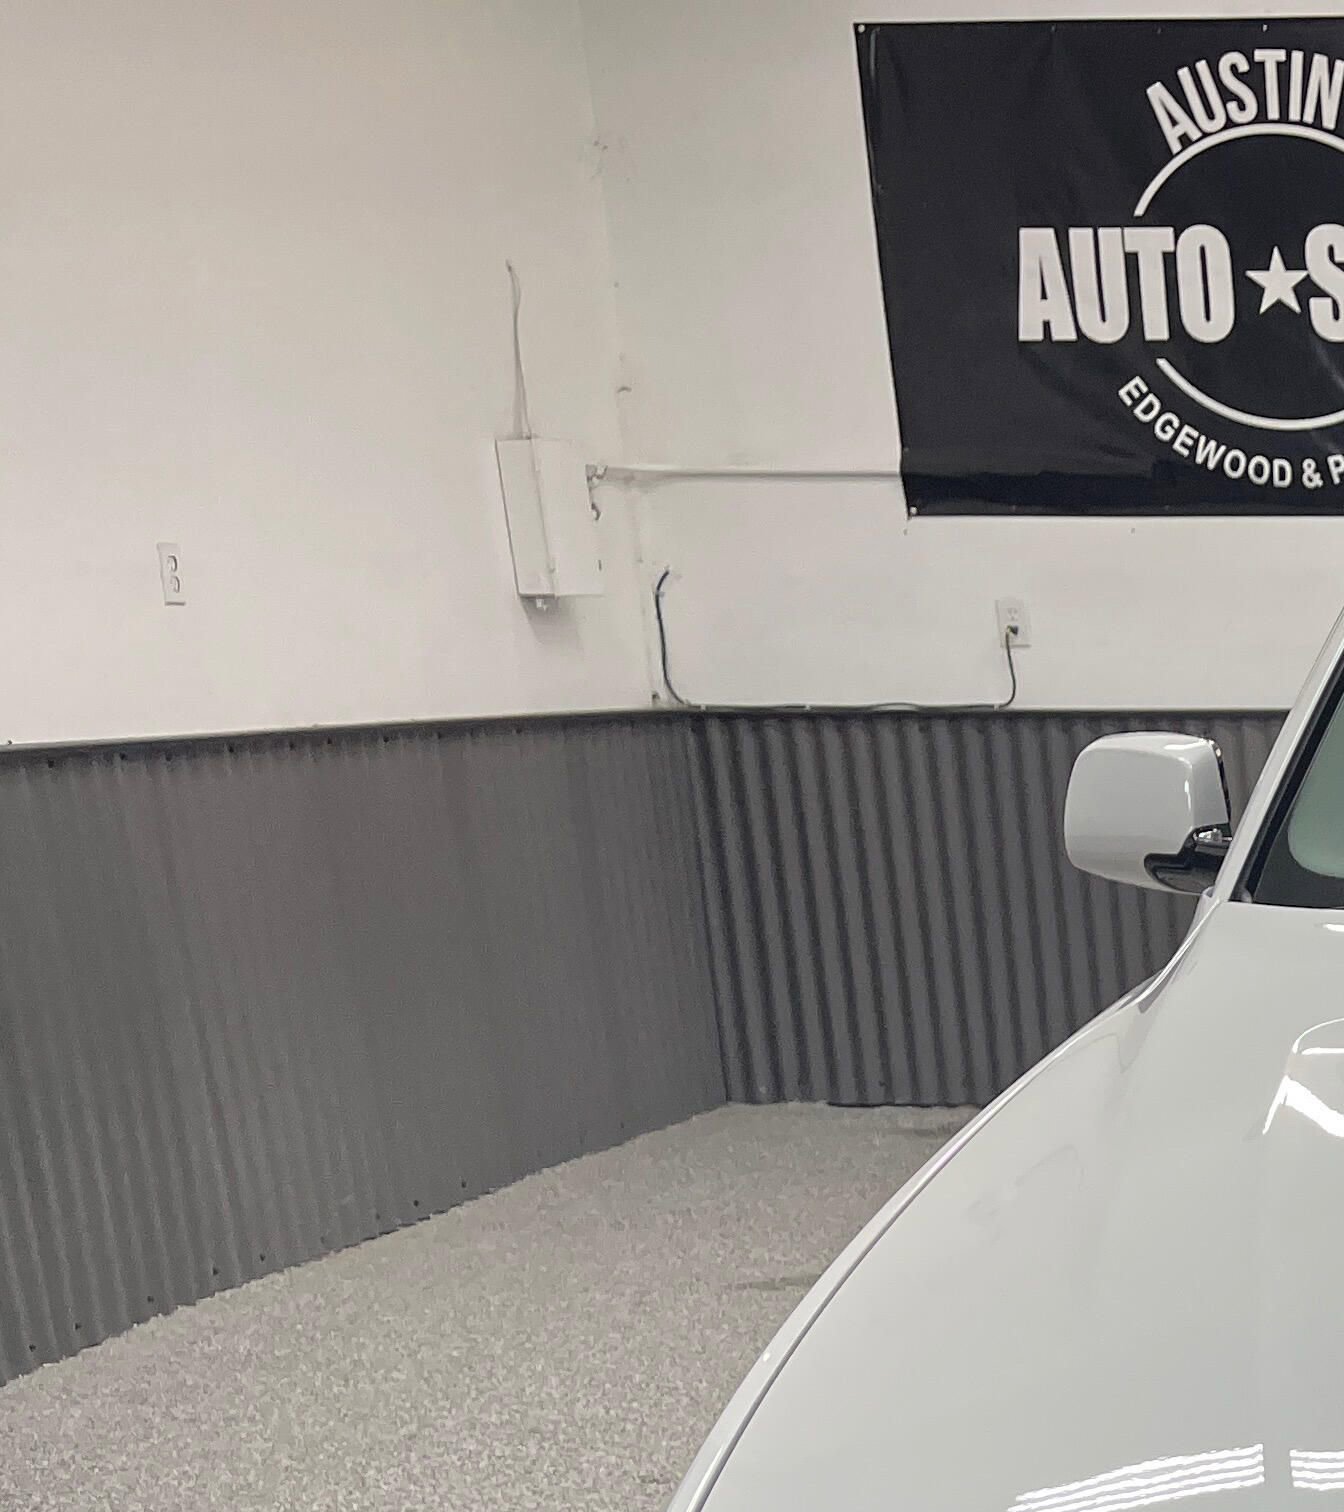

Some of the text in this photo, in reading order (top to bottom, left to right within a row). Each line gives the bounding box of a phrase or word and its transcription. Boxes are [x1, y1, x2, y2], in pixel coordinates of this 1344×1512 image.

[1018, 224, 1235, 344] AUTO
[1118, 375, 1293, 488] EDGEWOOD
[1302, 458, 1324, 489] &
